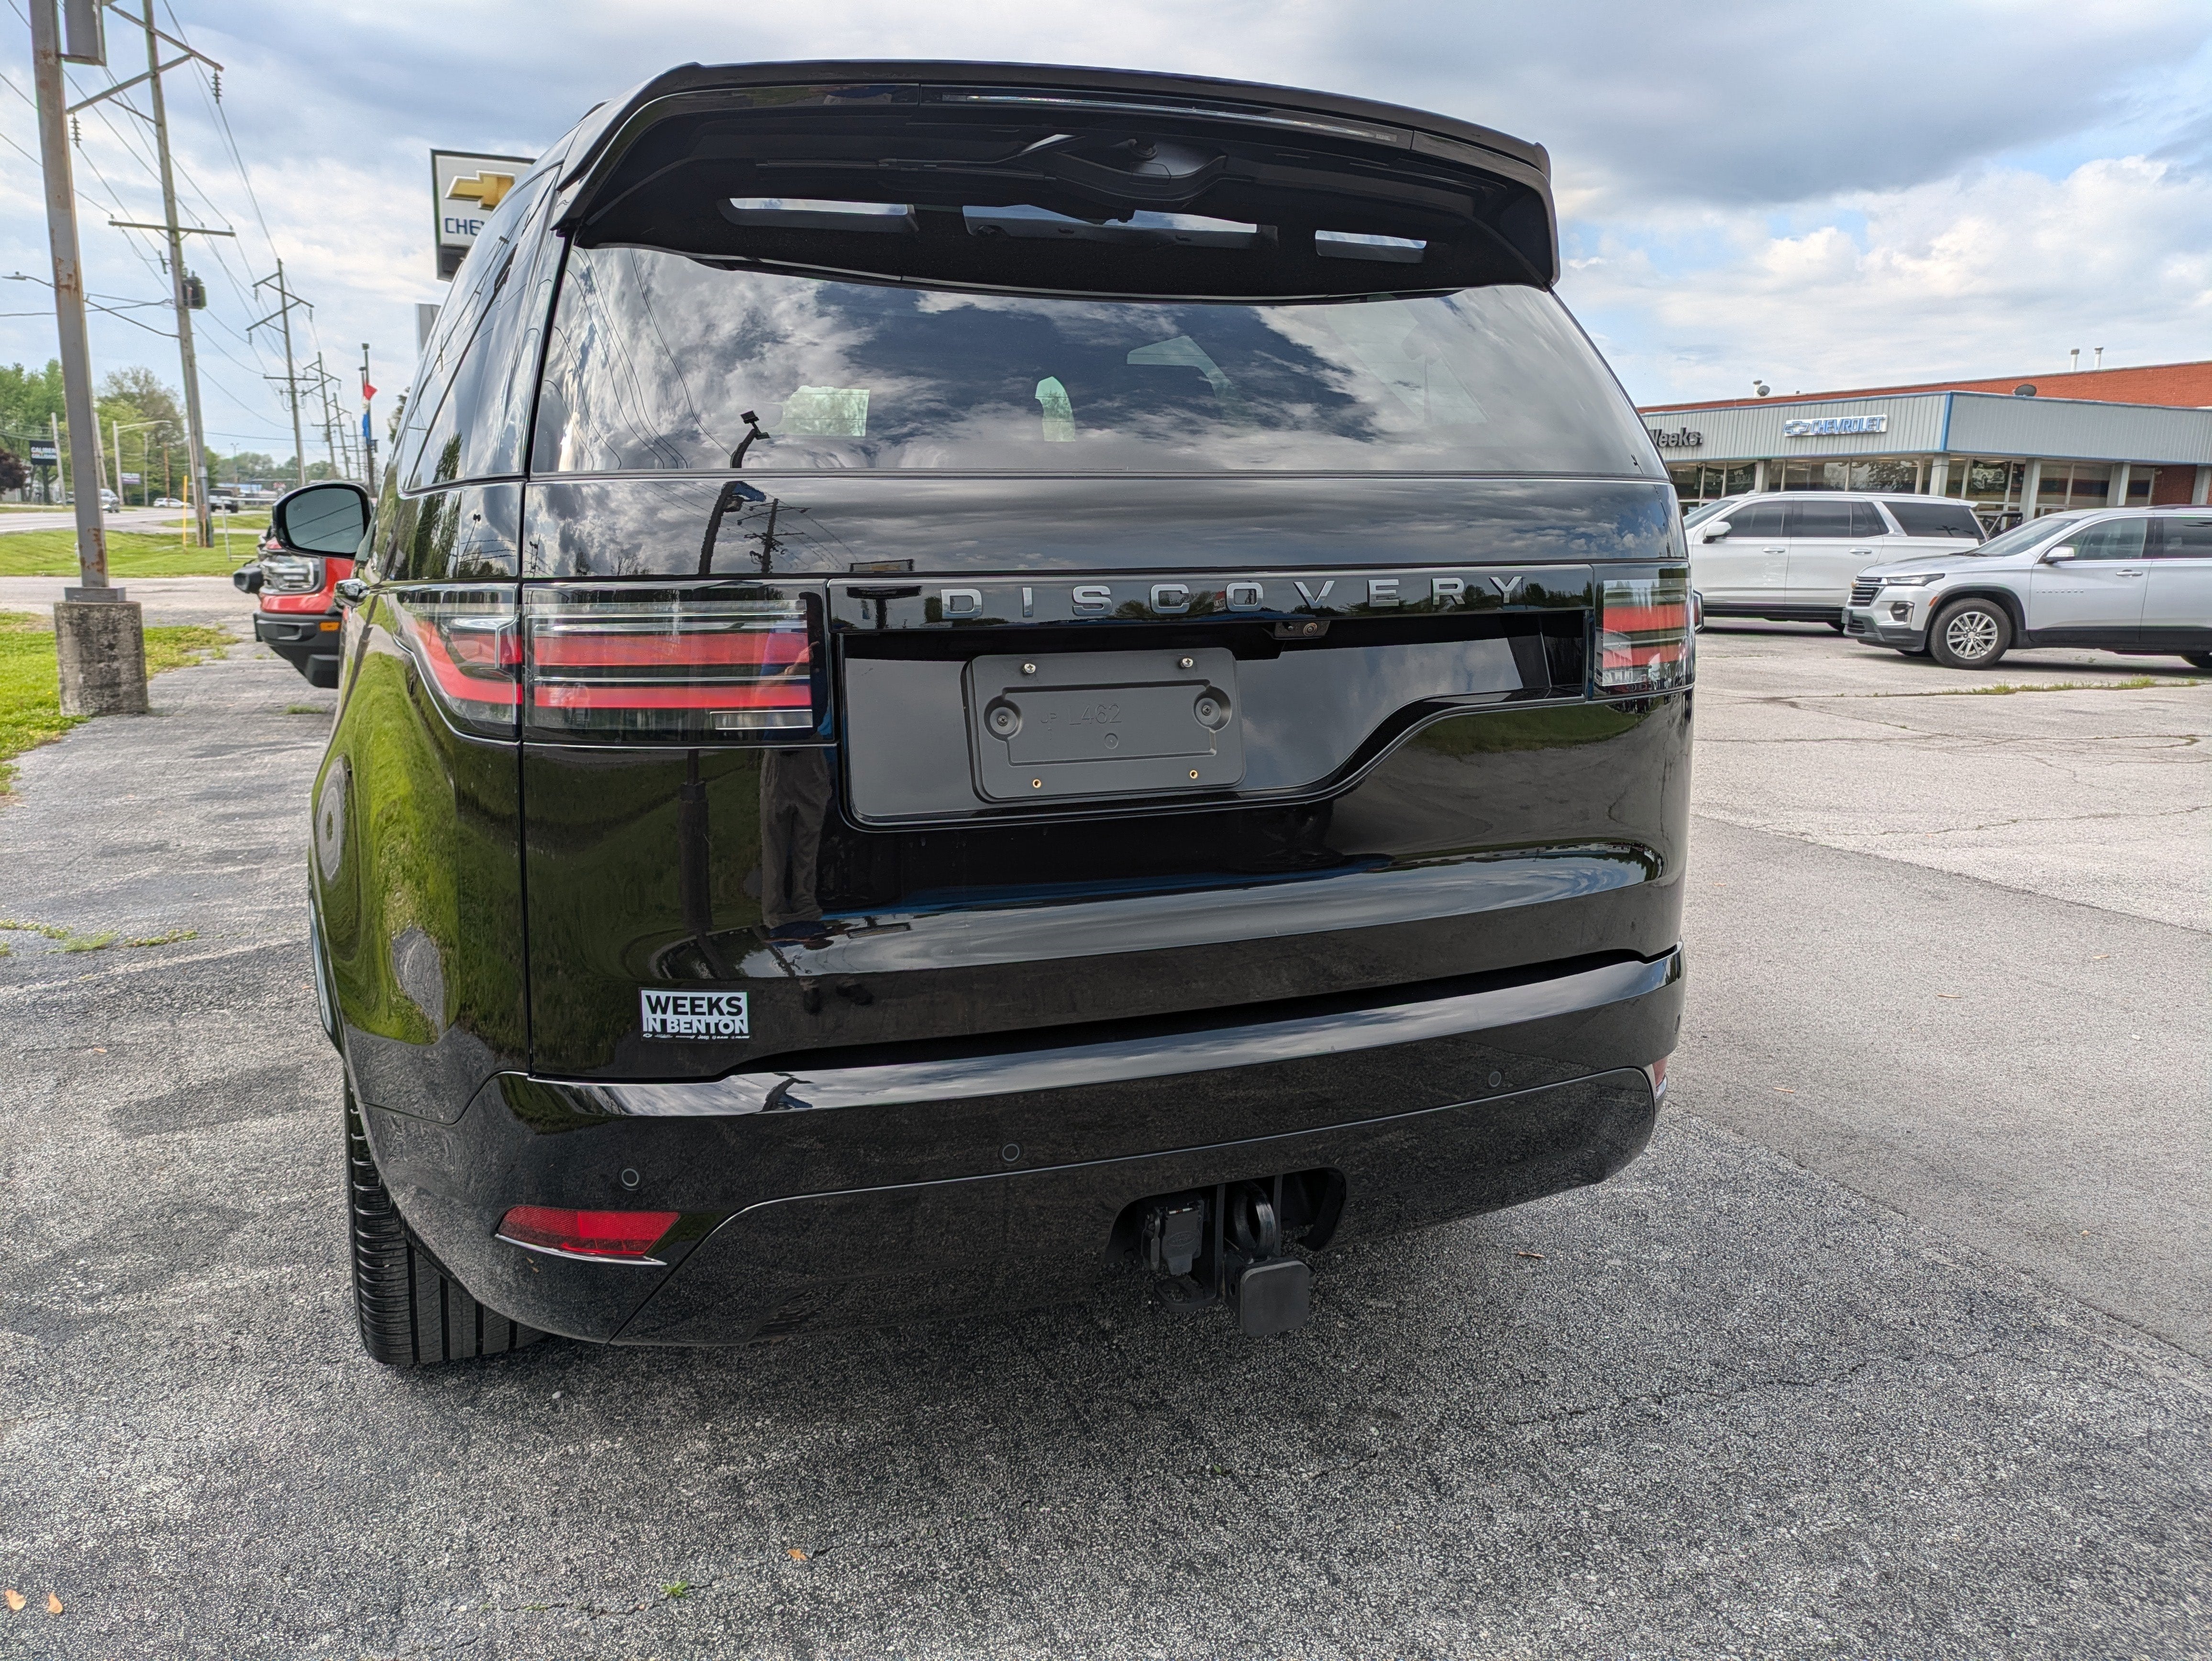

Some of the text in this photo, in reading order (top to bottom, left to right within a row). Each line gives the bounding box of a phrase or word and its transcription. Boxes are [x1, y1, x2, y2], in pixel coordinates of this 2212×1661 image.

[444, 217, 485, 236] CHE
[1811, 417, 1886, 433] CHEVROLET
[940, 576, 1523, 619] DISCOVERY
[1067, 704, 1122, 725] L462
[646, 995, 743, 1016] WEEKS
[643, 1018, 749, 1034] IN BENTON
